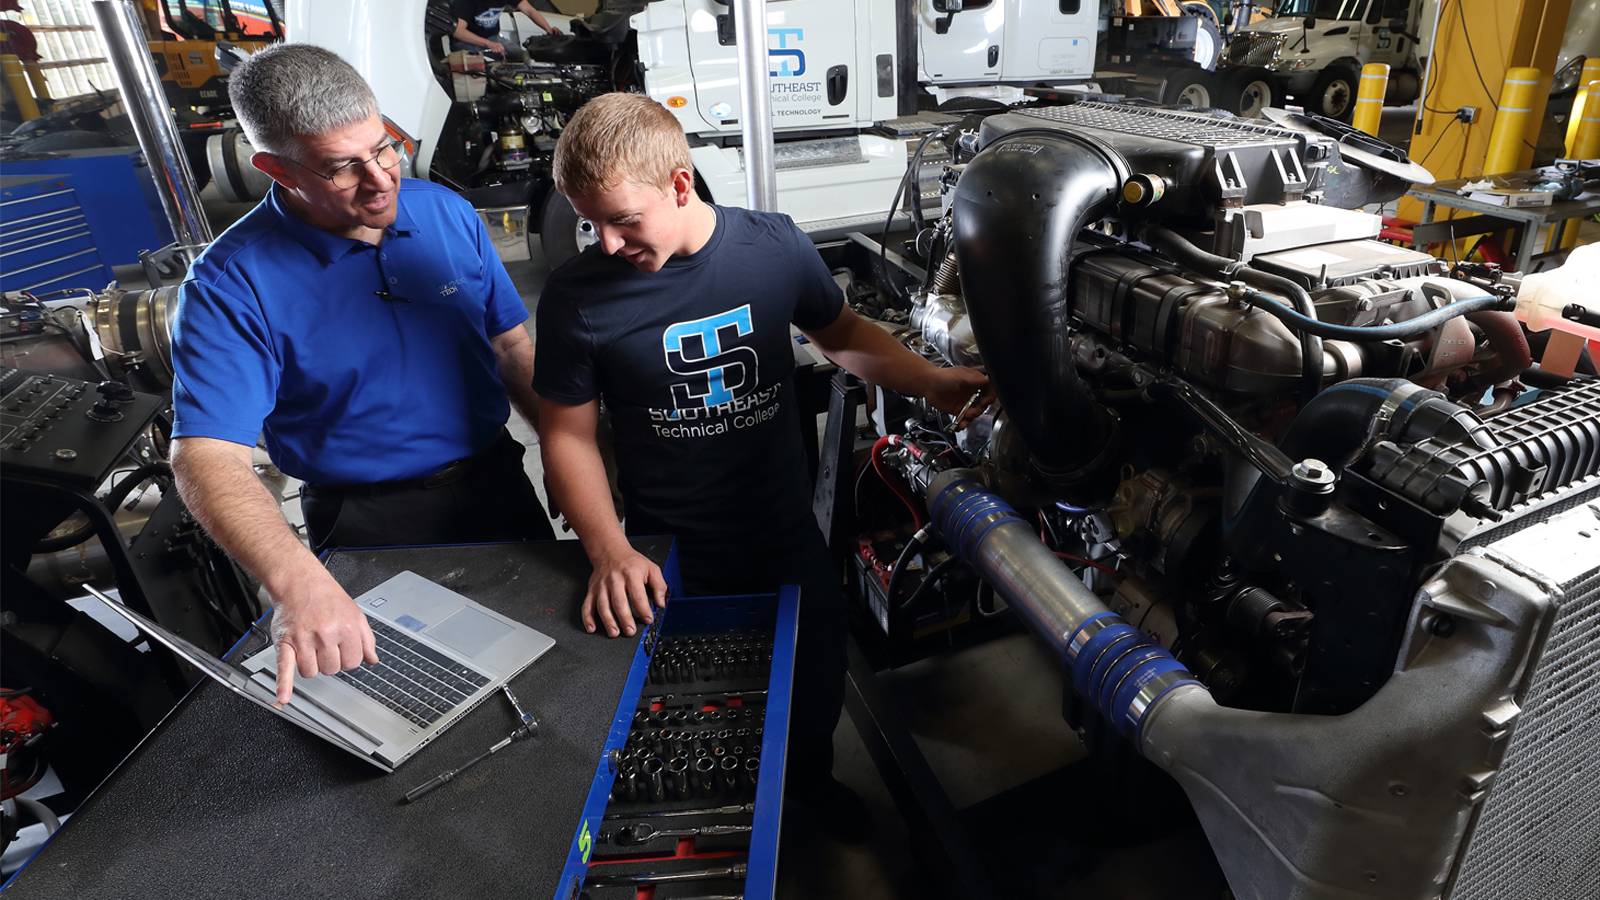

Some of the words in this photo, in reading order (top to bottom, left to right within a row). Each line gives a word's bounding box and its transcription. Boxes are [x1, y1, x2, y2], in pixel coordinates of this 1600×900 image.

[791, 93, 822, 103] College
[651, 418, 729, 439] Technical
[733, 402, 781, 429] College
